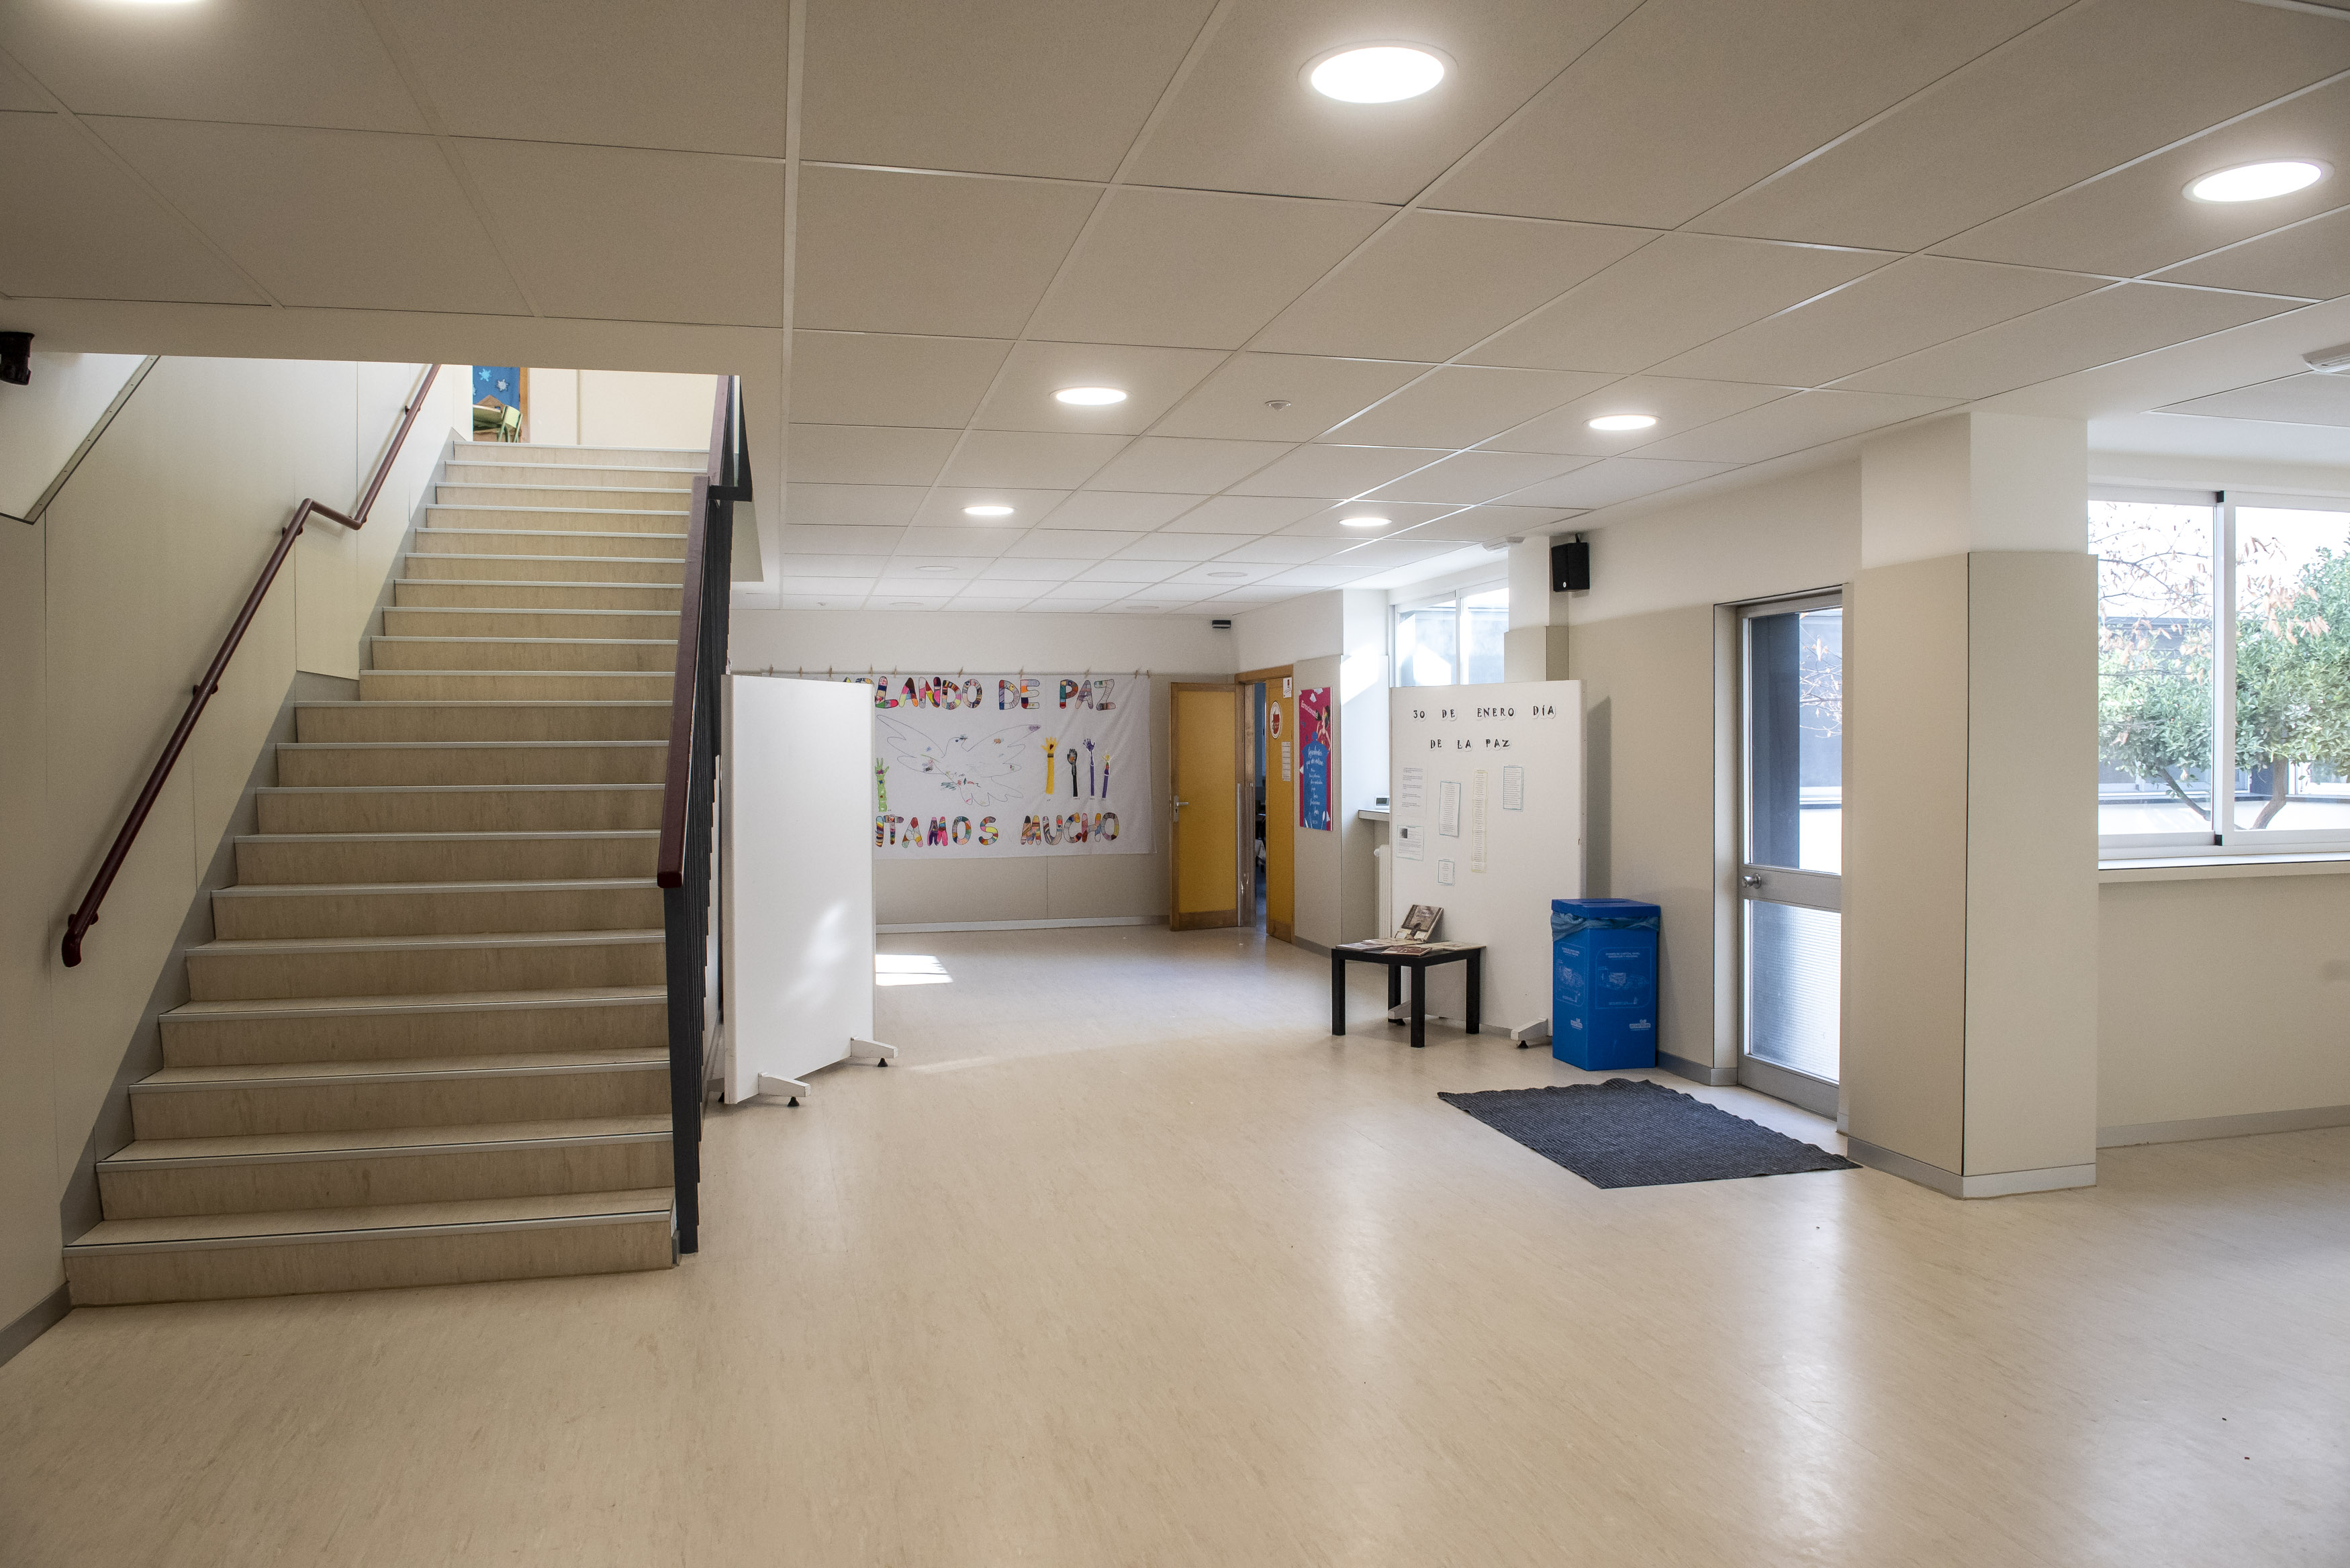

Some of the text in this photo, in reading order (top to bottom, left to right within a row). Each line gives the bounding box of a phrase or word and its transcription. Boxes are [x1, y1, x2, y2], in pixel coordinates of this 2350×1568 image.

[843, 676, 1117, 711] LANDO DE PAZ
[1413, 705, 1554, 718] 30 DE ENERO DÍA
[1430, 738, 1511, 749] DE LA PAZ
[1021, 812, 1120, 846] MUCHO
